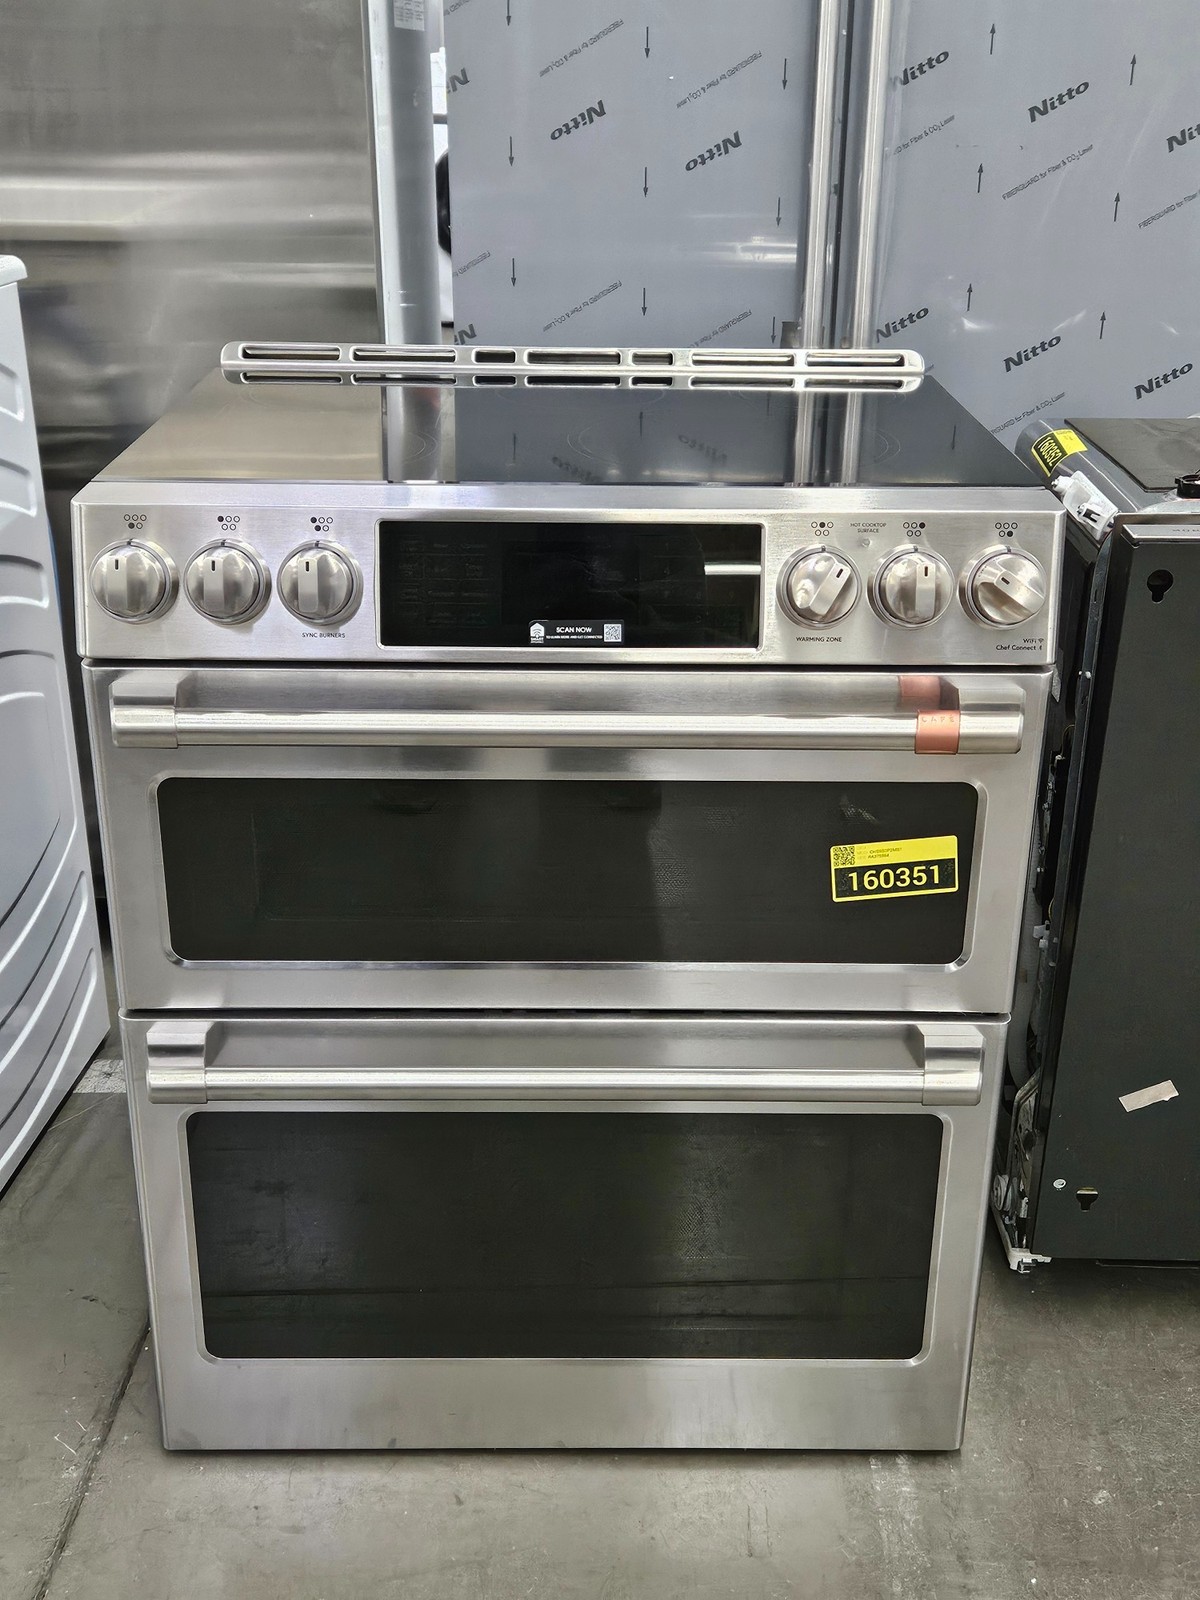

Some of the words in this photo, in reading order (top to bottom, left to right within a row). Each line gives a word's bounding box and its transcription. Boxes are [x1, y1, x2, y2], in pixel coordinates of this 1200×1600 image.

[550, 99, 606, 141] Nitto
[1027, 81, 1090, 123] Nitto
[685, 130, 742, 172] Nitto
[876, 307, 929, 344] Nitto
[1003, 335, 1062, 373] Nitto
[1134, 363, 1193, 400] Nitto
[848, 864, 940, 891] 160351
